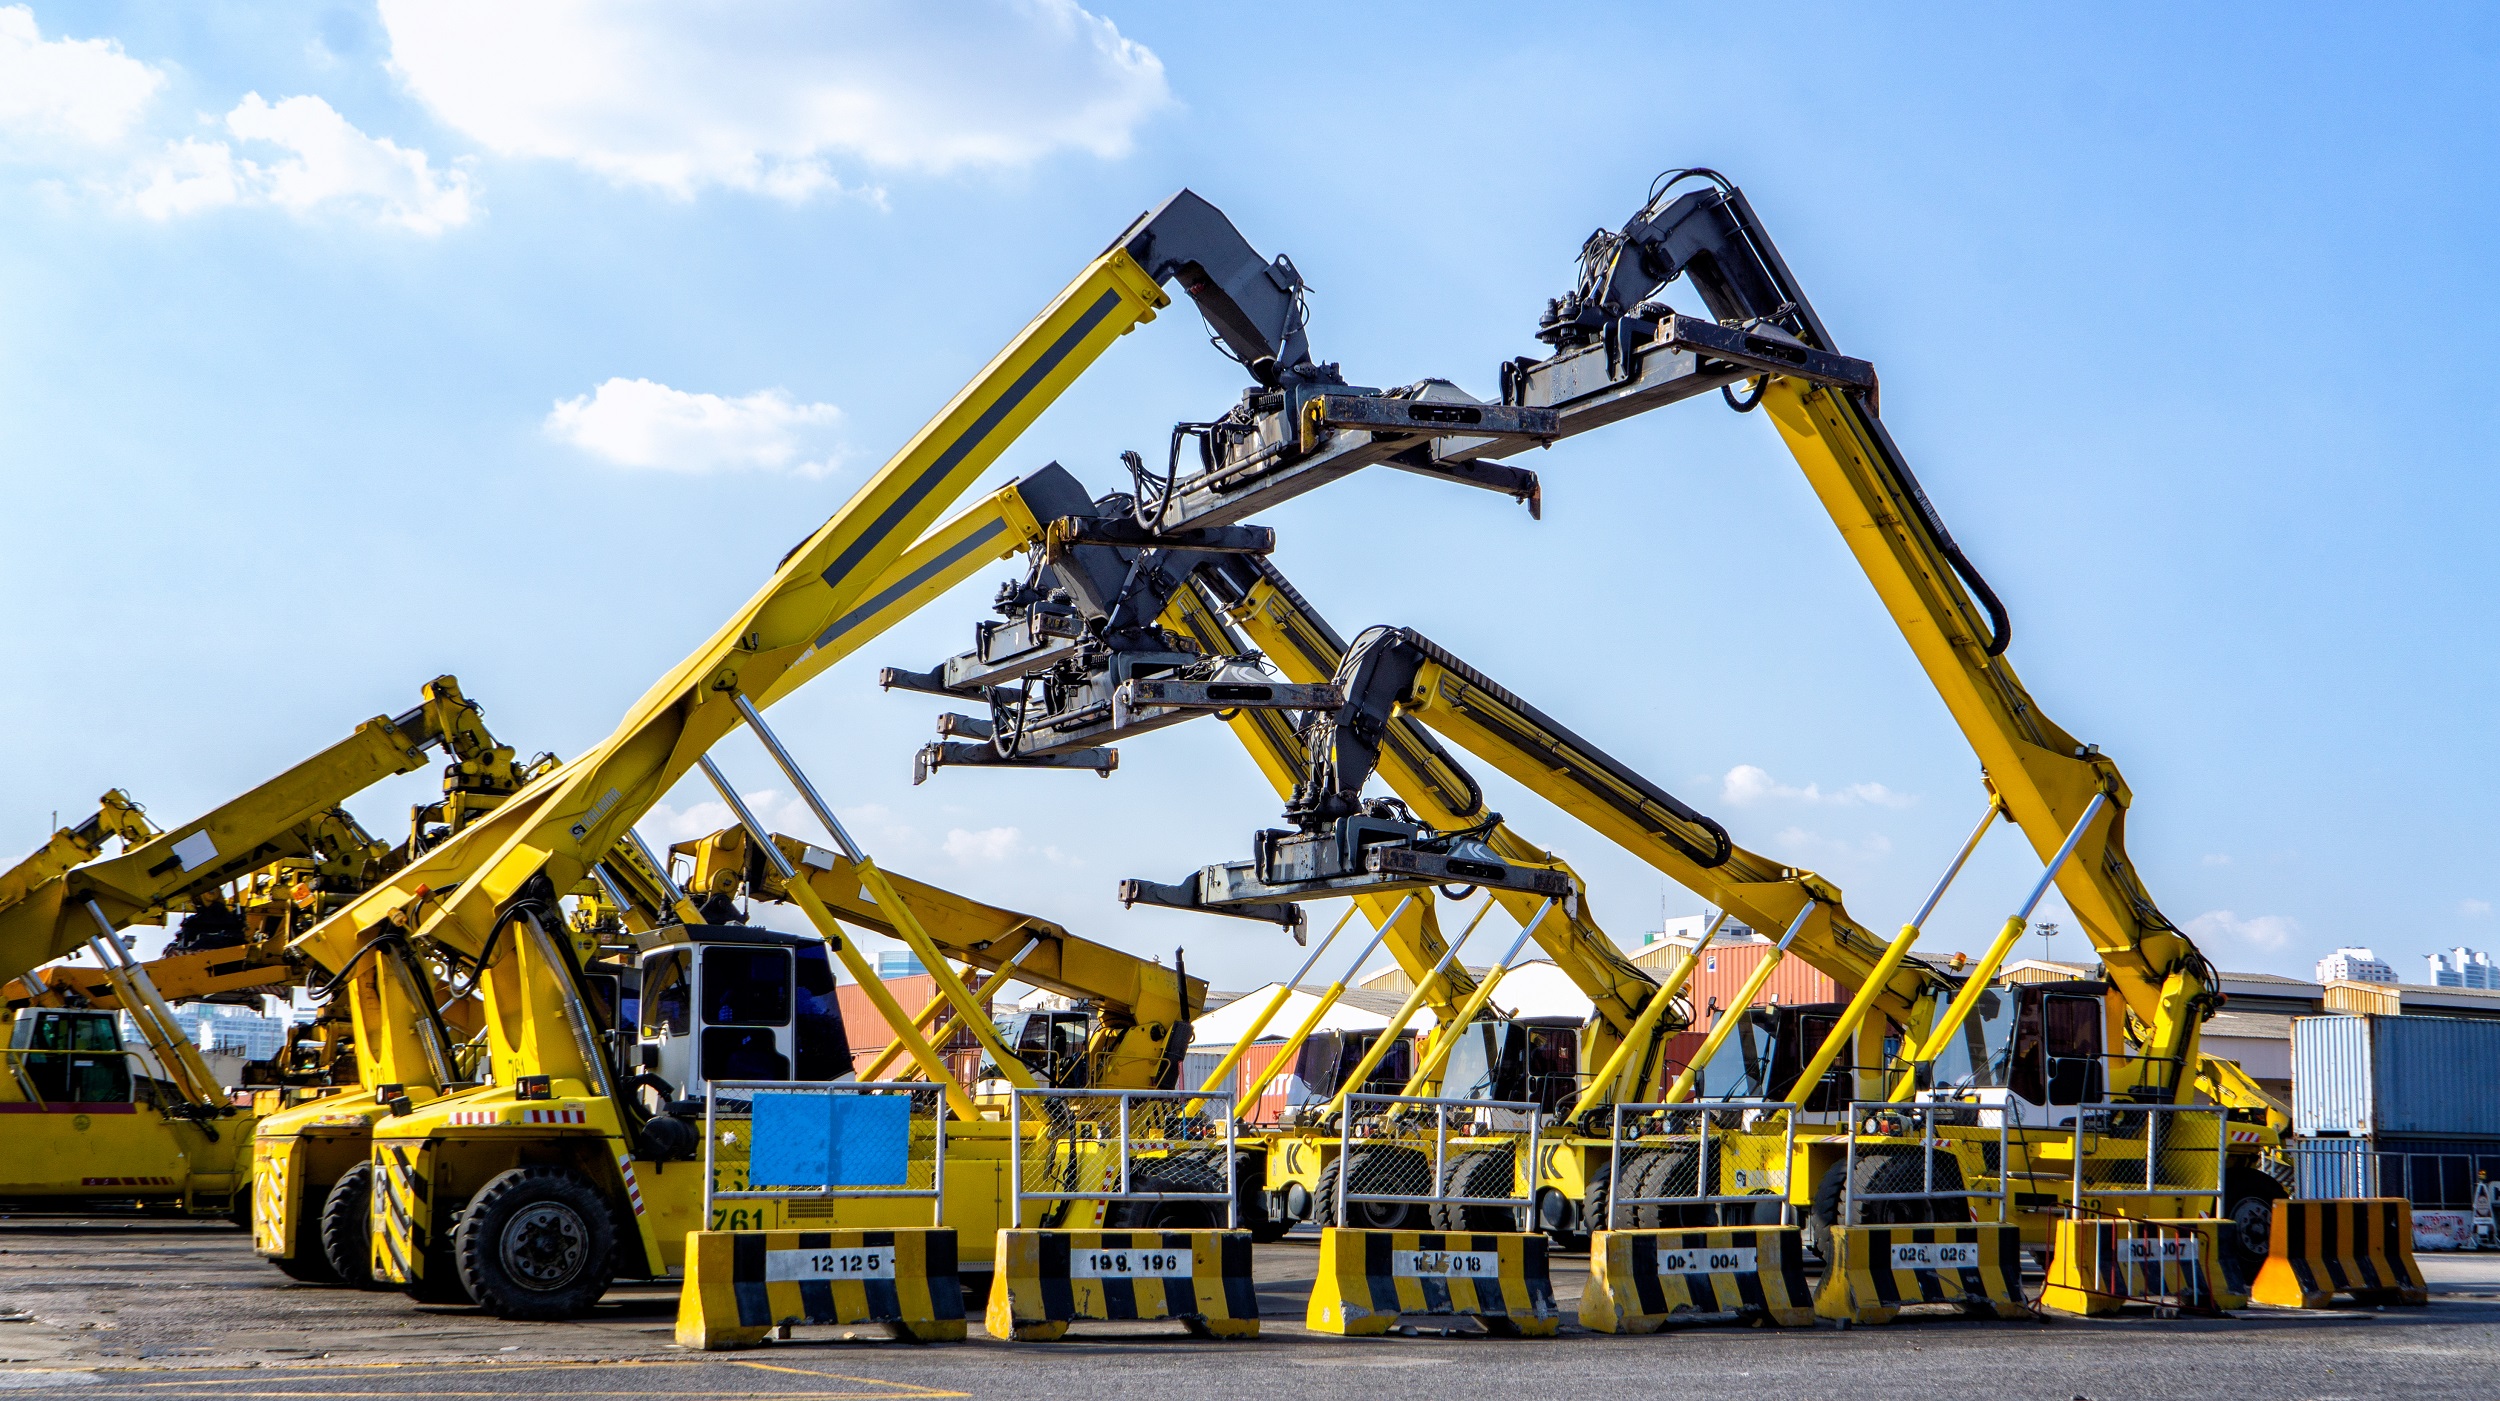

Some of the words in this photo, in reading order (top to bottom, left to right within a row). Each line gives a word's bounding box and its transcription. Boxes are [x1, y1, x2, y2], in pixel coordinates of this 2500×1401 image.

[1920, 498, 1945, 535] KALMAR
[581, 787, 622, 829] KALMAR
[712, 1207, 763, 1231] 761
[1142, 1254, 1177, 1271] 196
[1710, 1253, 1739, 1269] 004
[1940, 1247, 1966, 1262] 026
[1453, 1256, 1481, 1272] 018
